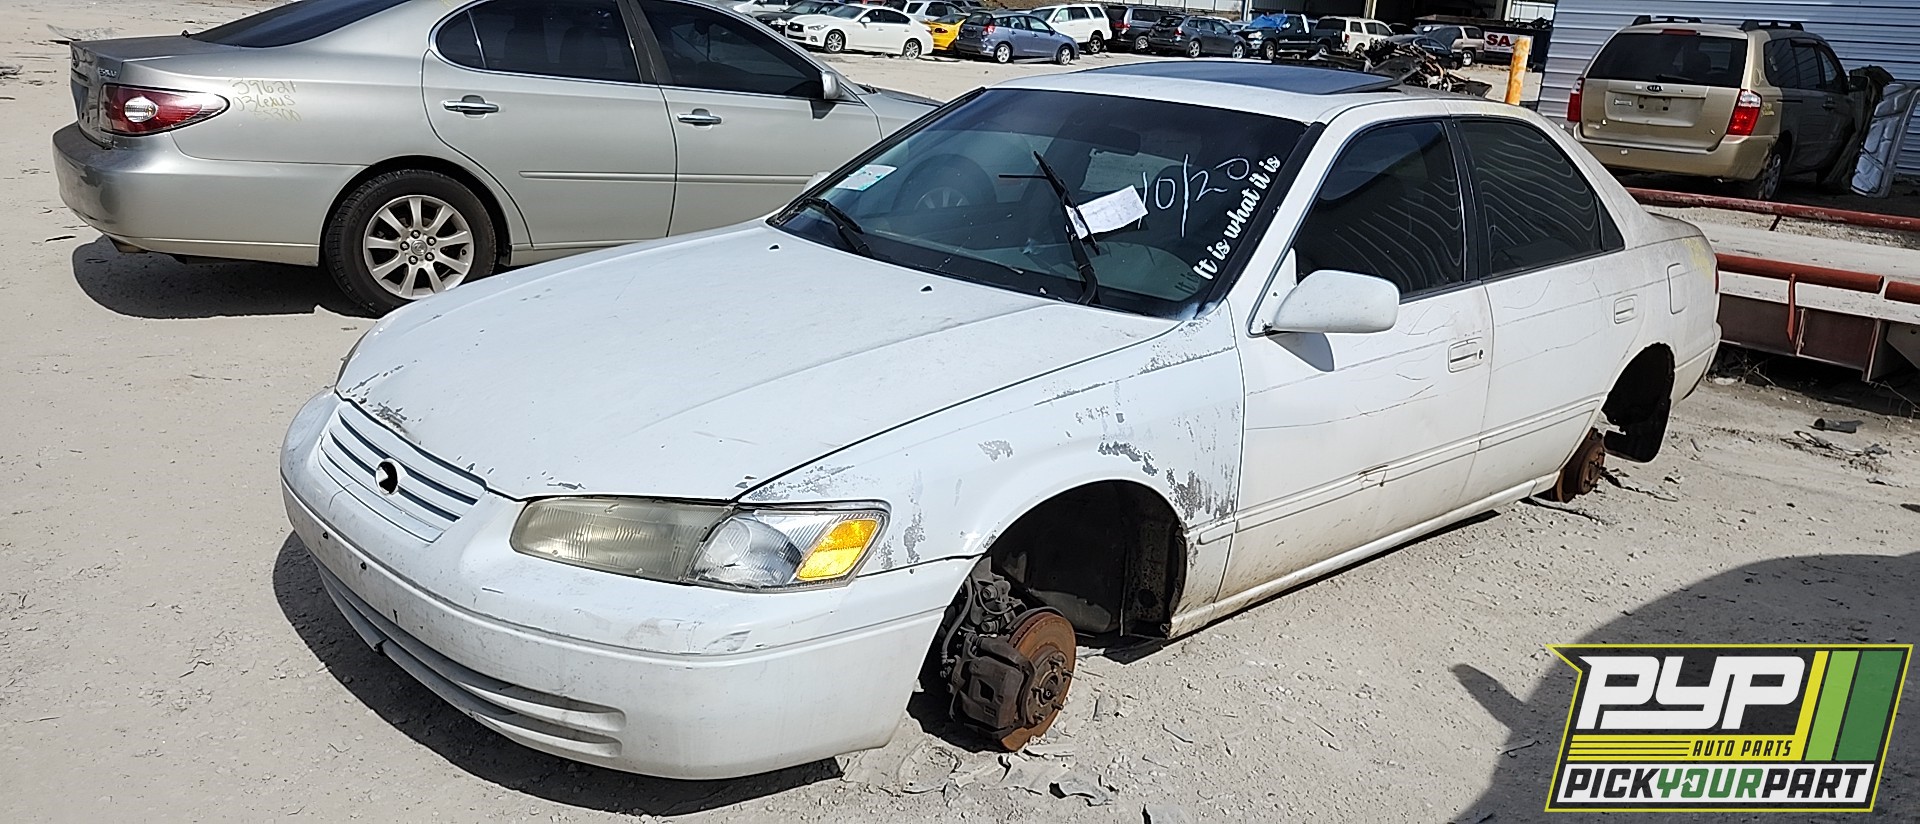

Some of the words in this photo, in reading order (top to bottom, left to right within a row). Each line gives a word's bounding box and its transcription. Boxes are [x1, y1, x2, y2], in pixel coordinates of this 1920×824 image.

[1259, 155, 1281, 174] is
[1249, 172, 1271, 190] it
[1223, 187, 1261, 239] what
[1206, 239, 1230, 261] is
[1193, 257, 1218, 280] It
